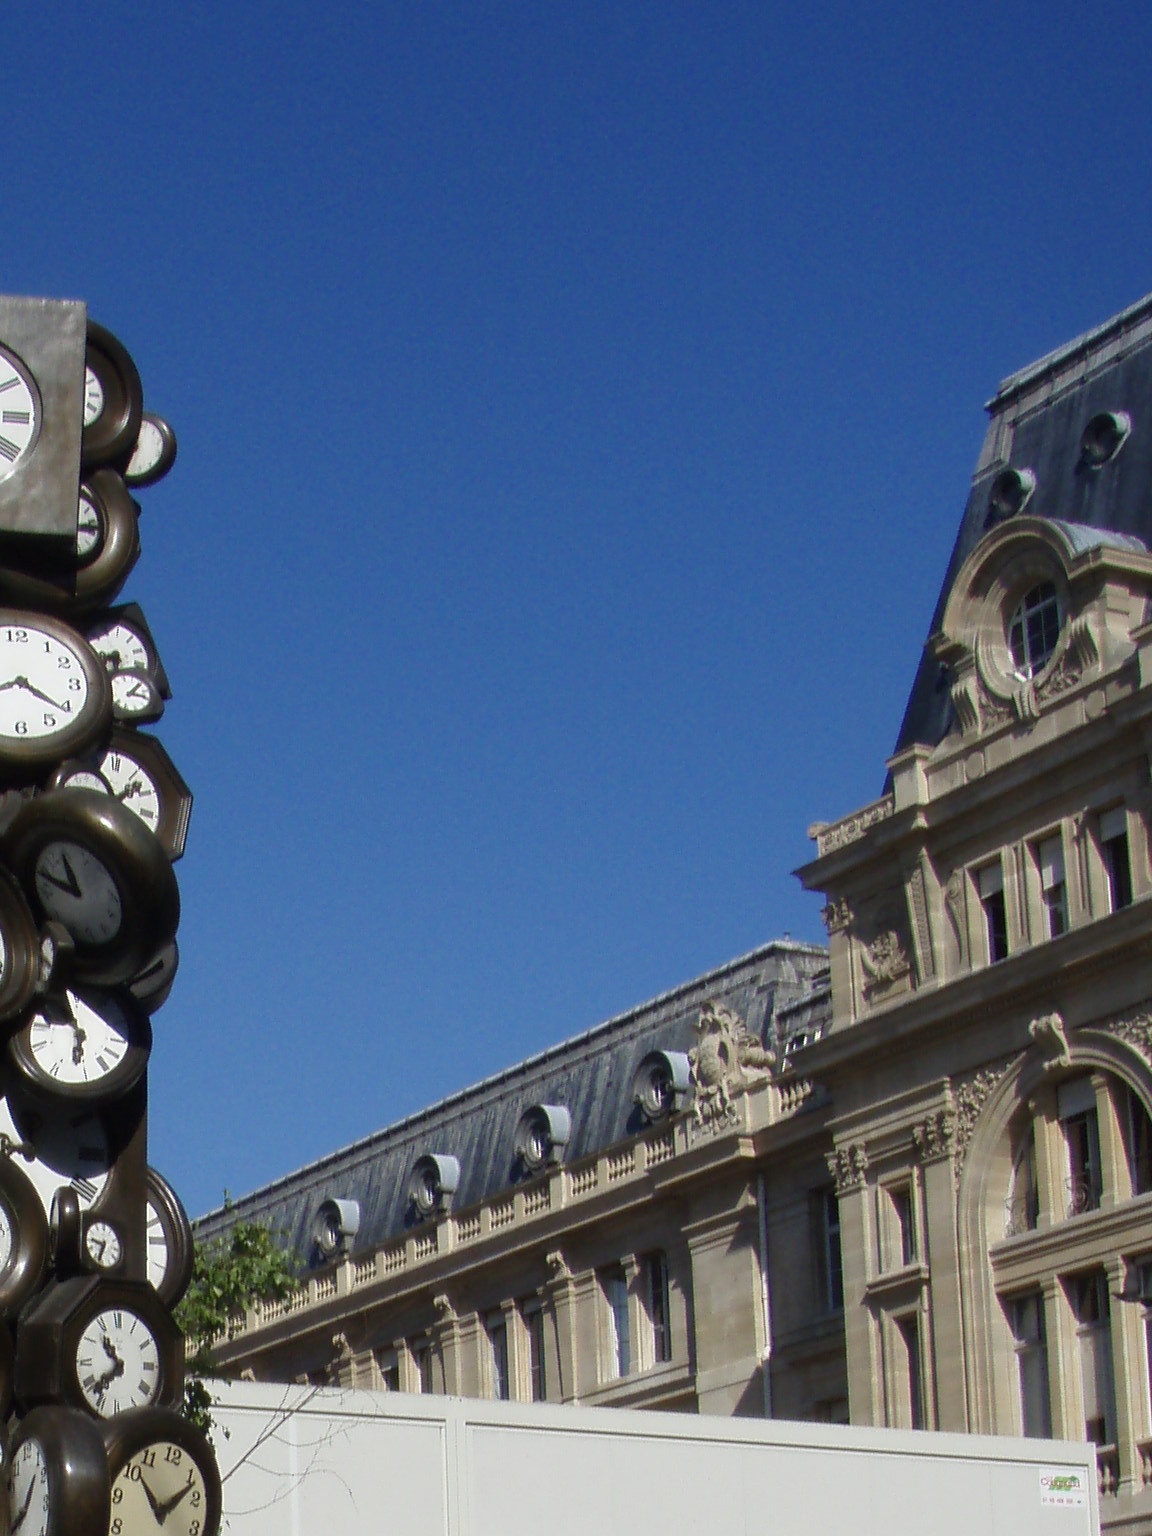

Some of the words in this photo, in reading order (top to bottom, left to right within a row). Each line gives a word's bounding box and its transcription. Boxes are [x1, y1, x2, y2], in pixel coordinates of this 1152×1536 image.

[6, 630, 29, 643] 12
[44, 641, 52, 653] 1
[58, 657, 71, 669] 2
[69, 678, 81, 691] 3
[61, 700, 71, 713] 4
[15, 721, 28, 734] 6
[44, 714, 56, 727] 5
[141, 1449, 156, 1468] 11
[164, 1446, 182, 1466] 12
[123, 1462, 142, 1481] 10
[186, 1469, 195, 1484] 1
[112, 1488, 123, 1504] 9
[190, 1491, 201, 1507] 2
[111, 1518, 123, 1535] 8
[189, 1520, 200, 1536] 3
